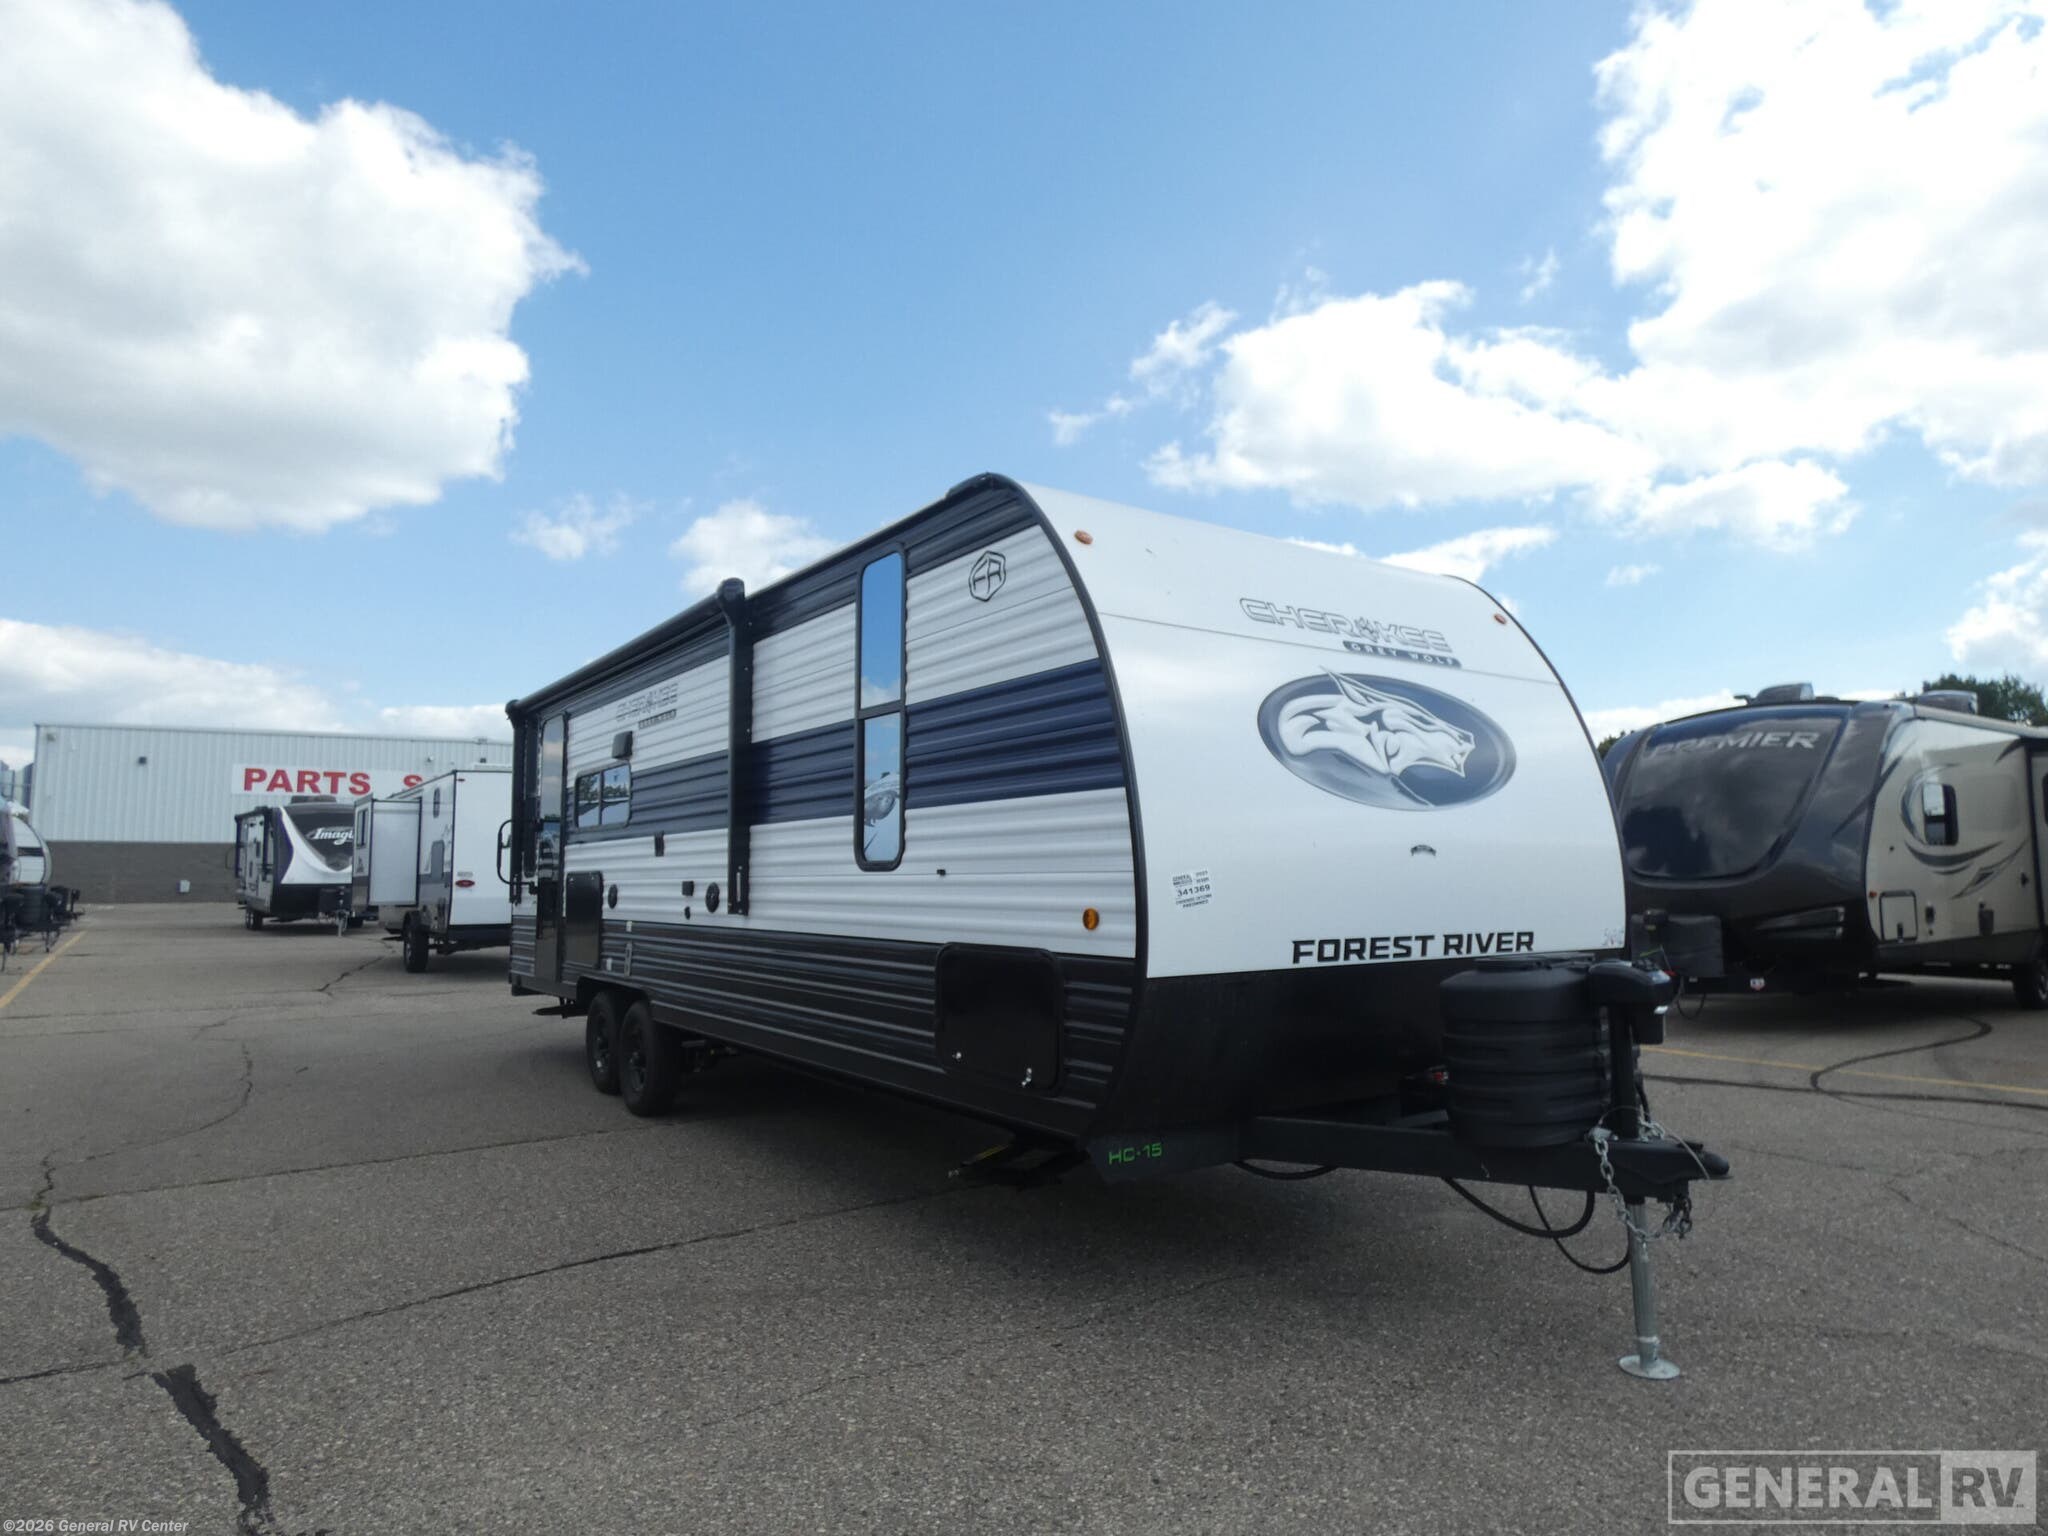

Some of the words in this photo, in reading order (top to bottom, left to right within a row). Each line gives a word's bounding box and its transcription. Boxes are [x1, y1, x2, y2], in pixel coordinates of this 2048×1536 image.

[1350, 643, 1398, 657] GREY
[1407, 652, 1455, 666] WOLF
[1652, 732, 1820, 756] PREMIER
[243, 768, 372, 796] PARTS
[1291, 935, 1436, 964] FOREST
[1443, 931, 1535, 956] RIVER
